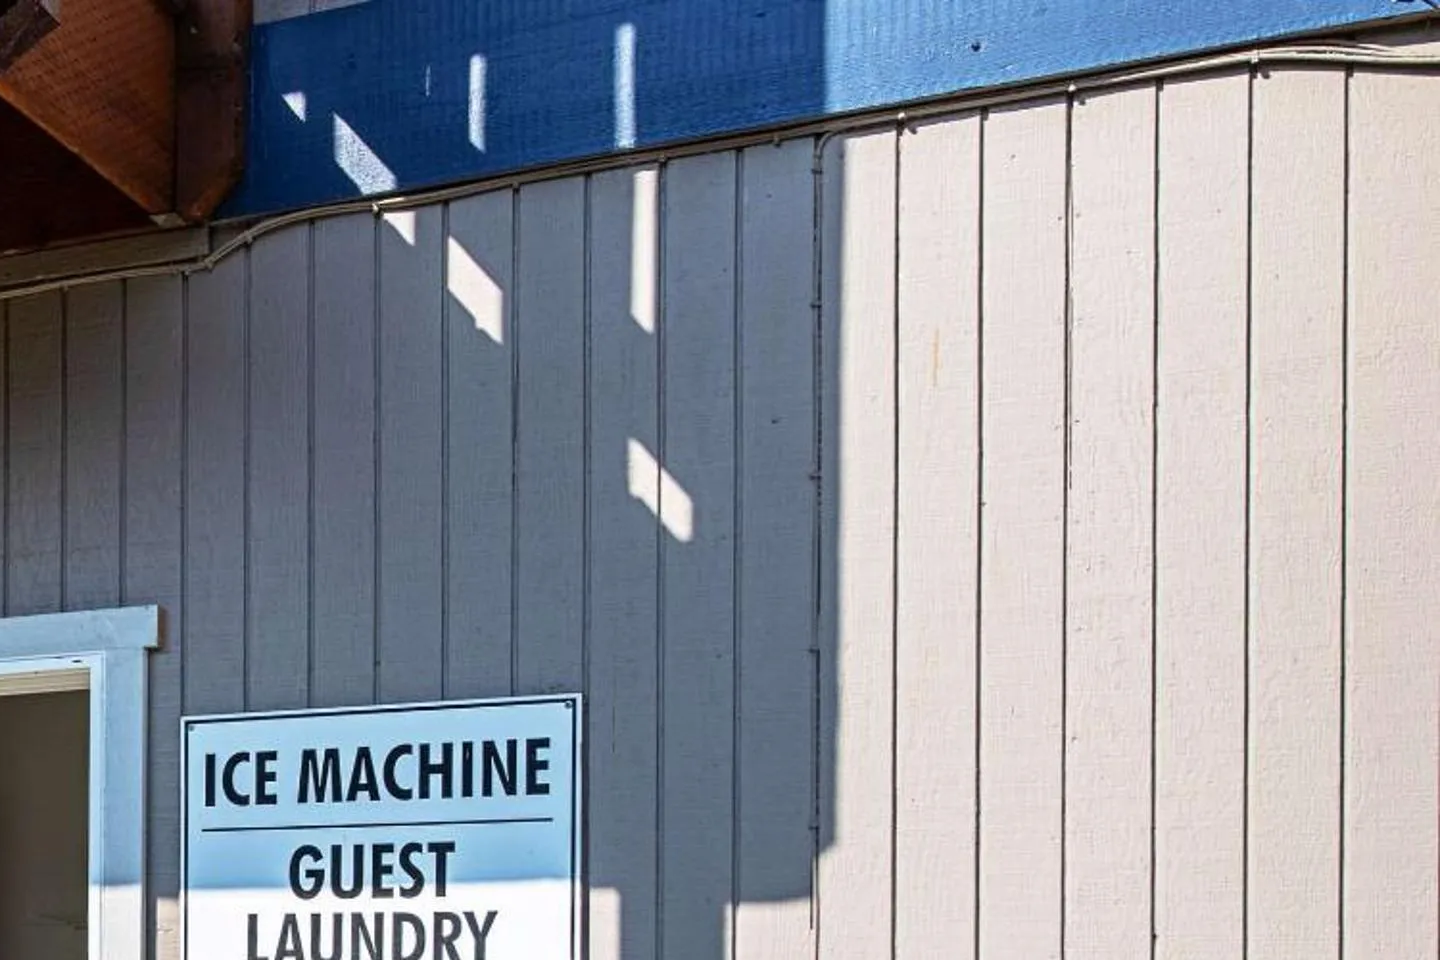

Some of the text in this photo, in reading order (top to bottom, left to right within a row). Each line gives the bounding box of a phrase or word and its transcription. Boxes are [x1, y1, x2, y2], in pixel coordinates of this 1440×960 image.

[204, 737, 551, 807] ICE MACHINE
[289, 841, 456, 900] GUEST
